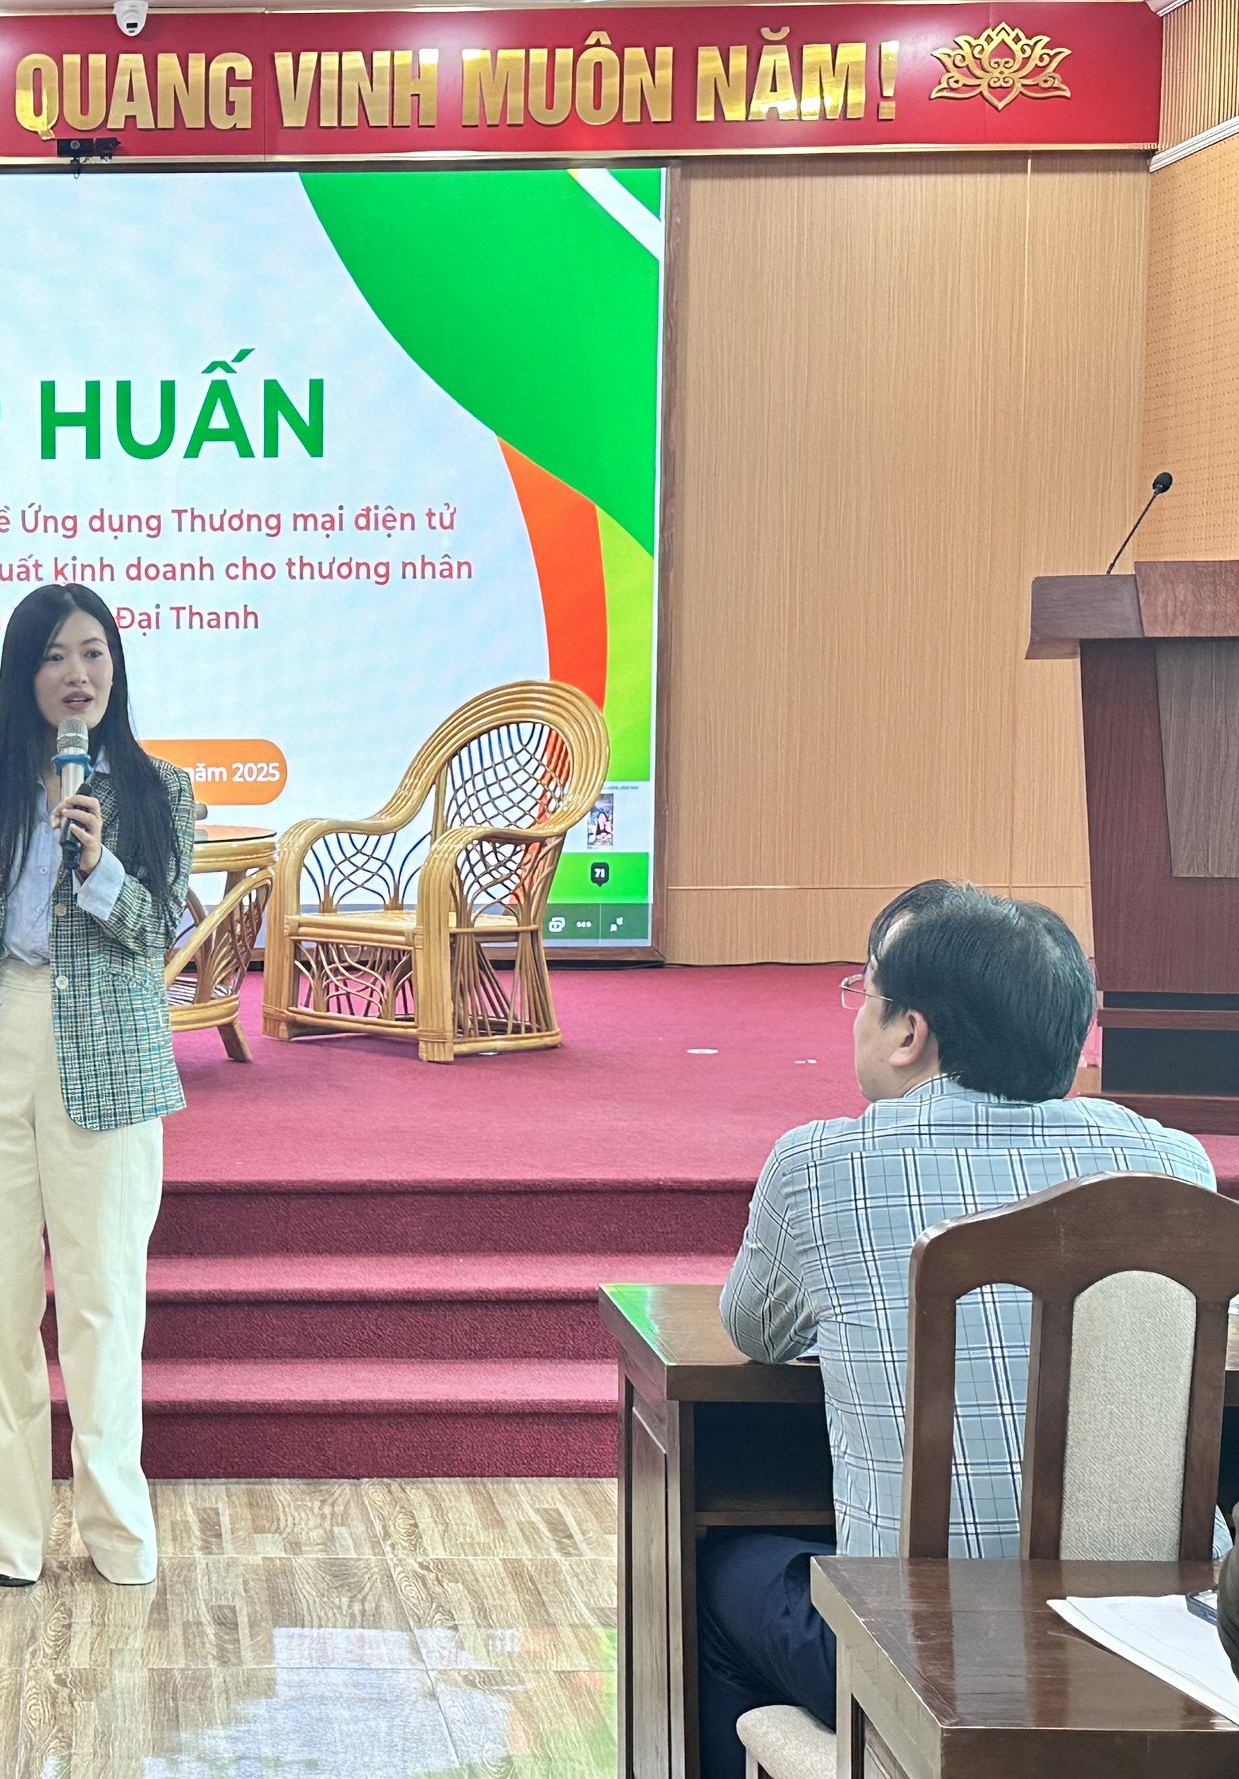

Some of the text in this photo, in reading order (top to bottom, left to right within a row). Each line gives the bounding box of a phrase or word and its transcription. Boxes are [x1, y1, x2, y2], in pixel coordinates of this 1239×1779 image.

[15, 53, 252, 140] QUANG
[274, 48, 440, 129] VINH
[462, 31, 673, 127] MUÔN
[41, 348, 324, 460] HUẤN
[21, 503, 79, 539] Ứng
[88, 508, 163, 540] dụng
[171, 508, 282, 538] Thương
[293, 505, 345, 539] mại
[354, 504, 417, 538] điện
[426, 502, 458, 532] tử
[53, 555, 116, 583] kinh
[125, 556, 216, 582] doanh
[225, 556, 278, 582] cho
[285, 556, 392, 586] thương
[401, 554, 474, 581] nhân
[115, 603, 161, 637] Đại
[170, 604, 261, 631] Thanh
[183, 762, 228, 783] năm
[231, 762, 281, 783] 2025
